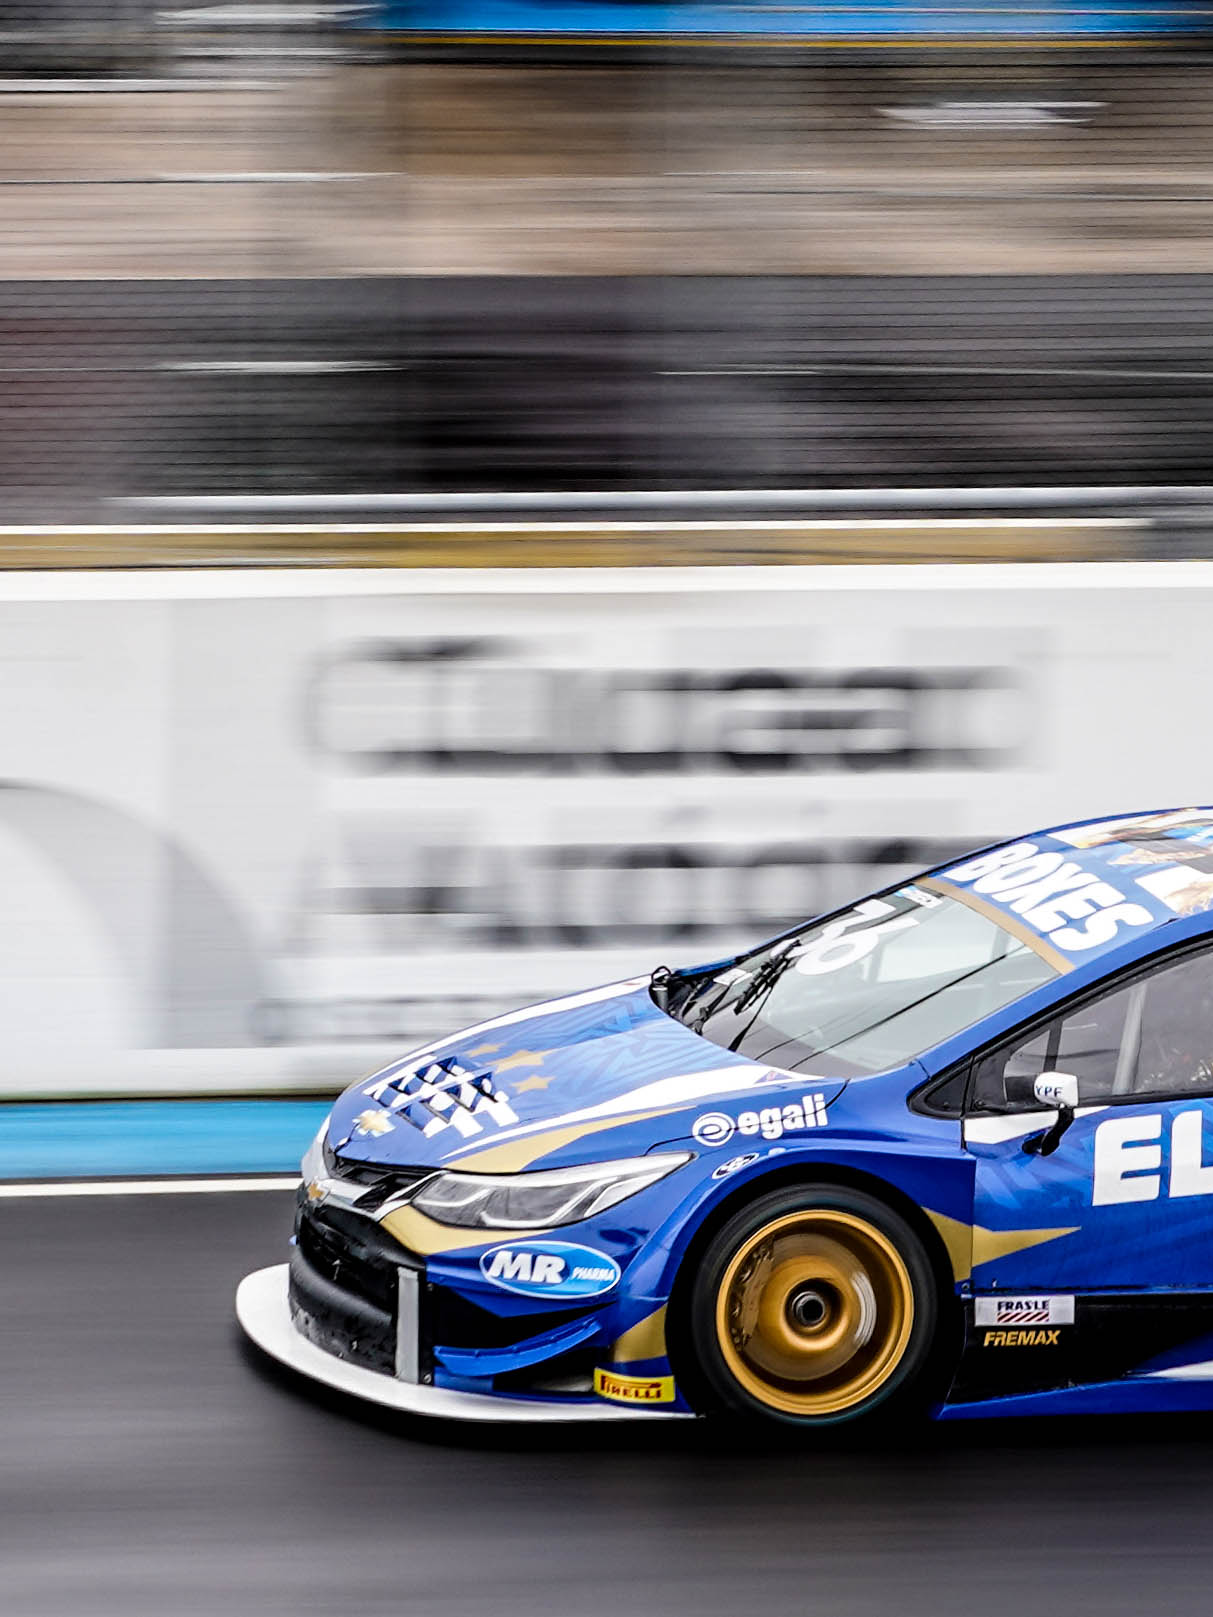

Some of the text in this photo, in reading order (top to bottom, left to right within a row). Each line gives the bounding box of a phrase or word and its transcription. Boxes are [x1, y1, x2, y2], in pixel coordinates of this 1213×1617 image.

[942, 842, 1154, 951] BOXES
[1035, 1084, 1064, 1098] YPF
[737, 1093, 828, 1140] egali
[486, 1250, 566, 1284] MR
[983, 1329, 1061, 1347] FREMAX
